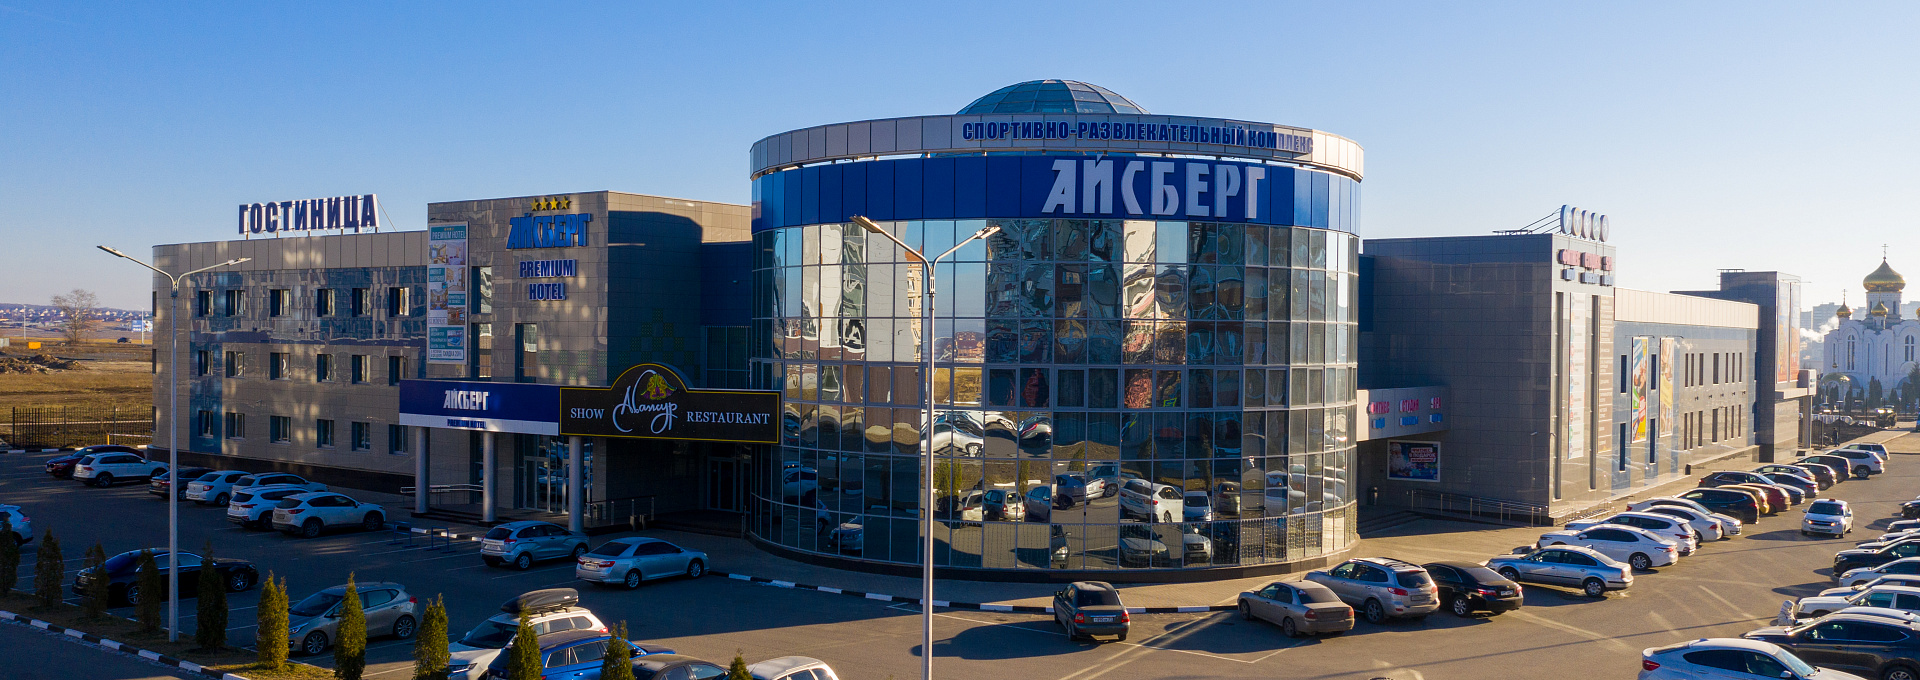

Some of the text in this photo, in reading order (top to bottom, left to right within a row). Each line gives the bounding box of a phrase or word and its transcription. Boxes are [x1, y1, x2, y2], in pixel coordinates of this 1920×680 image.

[962, 121, 1314, 154] СПОРТИВНО-РАЗВЛЕКАТЕЛЬНЫЙ КОМПЛЕКС
[1041, 154, 1266, 219] АЙСБЕРГ
[238, 193, 380, 235] ГОСТИНИЦА
[452, 230, 466, 239] HOTEL
[506, 213, 592, 249] АЙСБЕРГ
[519, 258, 577, 278] PREMIUM
[528, 282, 567, 300] HOTEL
[443, 388, 491, 411] АЙСБЕРГ
[570, 406, 605, 421] SHOW
[687, 410, 771, 425] RESTAURANT
